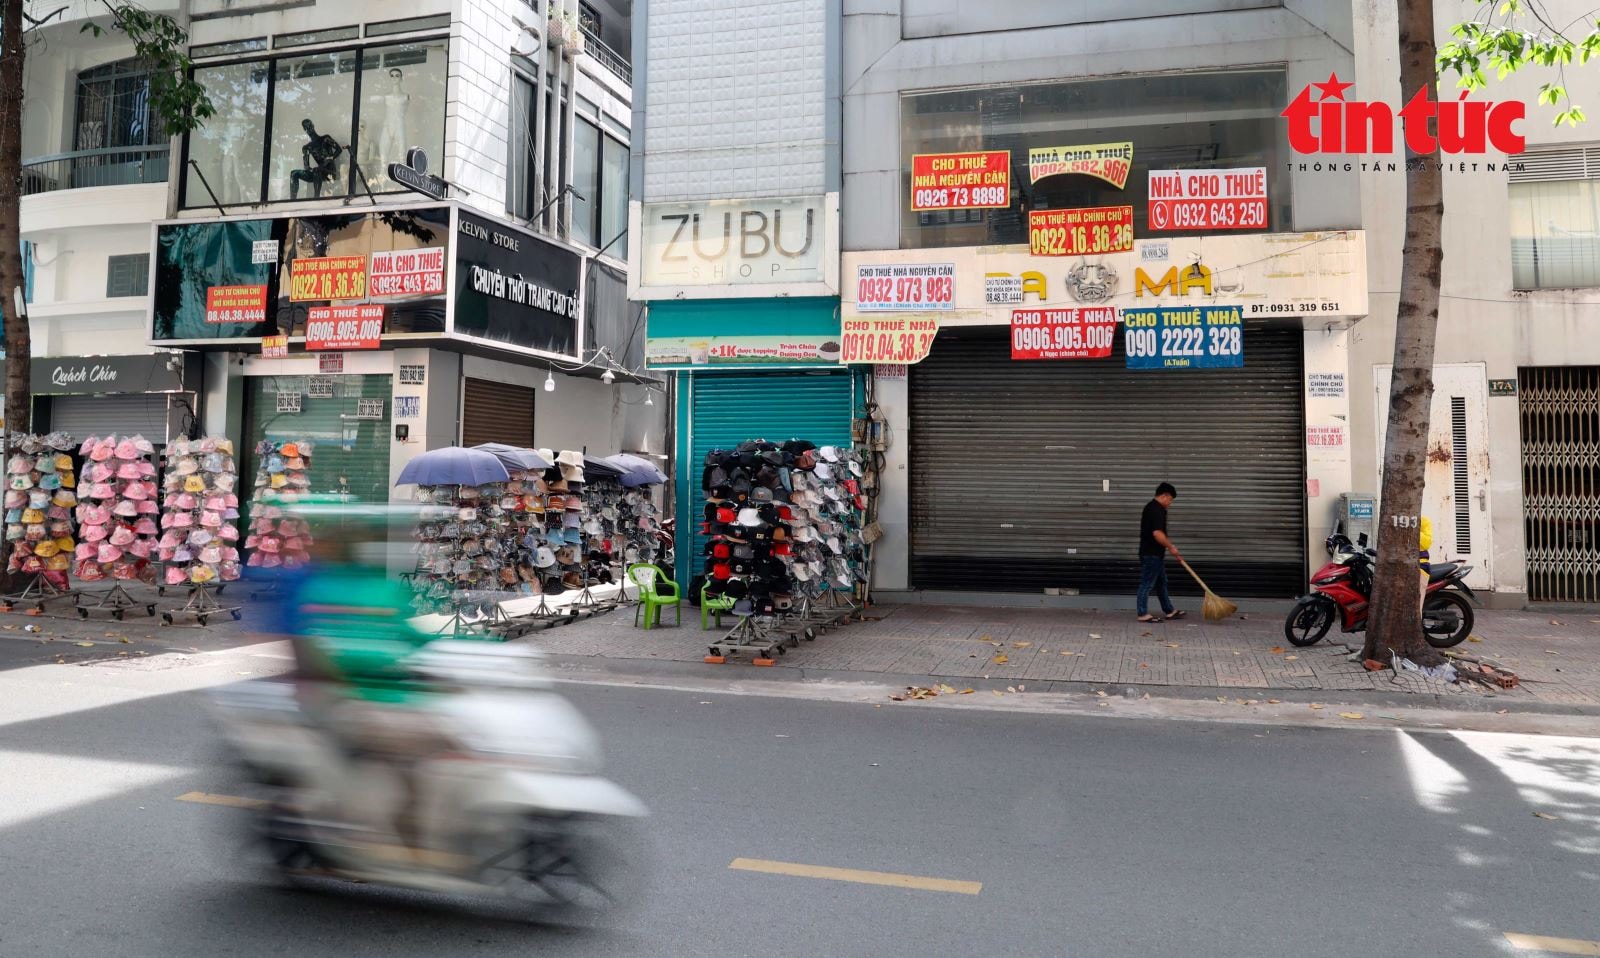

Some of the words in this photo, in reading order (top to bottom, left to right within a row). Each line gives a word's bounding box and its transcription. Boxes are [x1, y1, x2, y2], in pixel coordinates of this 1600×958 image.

[932, 158, 955, 170] CHO
[959, 155, 987, 169] THUÊ
[1031, 149, 1059, 163] NHÀ
[1065, 150, 1091, 161] CHO
[1096, 144, 1131, 160] THUÊ
[396, 168, 419, 184] KELVIN
[420, 179, 440, 193] STORE
[915, 173, 936, 187] NHÀ
[940, 171, 981, 186] NGUYÊN
[984, 170, 1006, 184] CĂN
[1031, 159, 1128, 185] 0902.582.966
[1151, 172, 1183, 197] NHÀ
[1188, 175, 1219, 197] CHO
[1224, 169, 1264, 196] THUÊ
[916, 189, 948, 207] 0926
[951, 187, 968, 206] 73
[972, 186, 1004, 205] 9898
[1031, 216, 1046, 225] CHO
[1048, 212, 1065, 224] THUÊ
[1068, 211, 1082, 223] NHÀ
[1083, 209, 1105, 222] CHÍNH
[1107, 207, 1122, 221] CHỦ
[1173, 203, 1206, 226] 0932
[1210, 203, 1235, 226] 643
[1239, 202, 1264, 225] 250
[458, 219, 488, 240] KELVIN
[493, 232, 520, 252] STORE
[661, 208, 814, 263] ZUBU
[1031, 224, 1132, 255] 0922.16.36.36
[372, 252, 393, 273] NHÀ
[396, 254, 416, 271] CHO
[418, 249, 443, 270] THUÊ
[692, 263, 781, 278] SHOP
[860, 268, 873, 277] CHO
[875, 266, 891, 276] THUÊ
[292, 271, 365, 300] 0922.16.36.36
[378, 275, 403, 294] 0932
[404, 274, 422, 292] 643
[424, 272, 442, 292] 250
[473, 265, 505, 298] CHUYÊN
[527, 283, 551, 311] TRANG
[551, 290, 566, 316] CAO
[859, 278, 893, 303] 0932
[896, 277, 922, 302] 973
[926, 277, 952, 302] 983
[207, 309, 265, 321] 08.48.38.4444
[309, 309, 330, 319] CHO
[333, 306, 358, 318] THUÊ
[361, 306, 383, 318] NHÀ
[1013, 312, 1041, 325] CHO
[1045, 308, 1079, 324] THUÊ
[1084, 307, 1114, 323] NHÀ
[1125, 312, 1157, 328] CHO
[1161, 308, 1202, 326] THUÊ
[1206, 307, 1241, 325] NHÀ
[1299, 303, 1317, 312] 319
[1321, 303, 1340, 311] 651
[306, 319, 382, 341] 0906.905.006
[844, 321, 870, 331] CHO
[873, 320, 905, 331] THUÊ
[909, 320, 936, 331] NHÀ
[1014, 325, 1114, 351] 0906.905.006
[1125, 328, 1157, 357] 090
[1161, 327, 1204, 356] 2222
[1208, 326, 1241, 356] 328
[52, 366, 87, 386] Quách
[1391, 515, 1418, 528] 193
